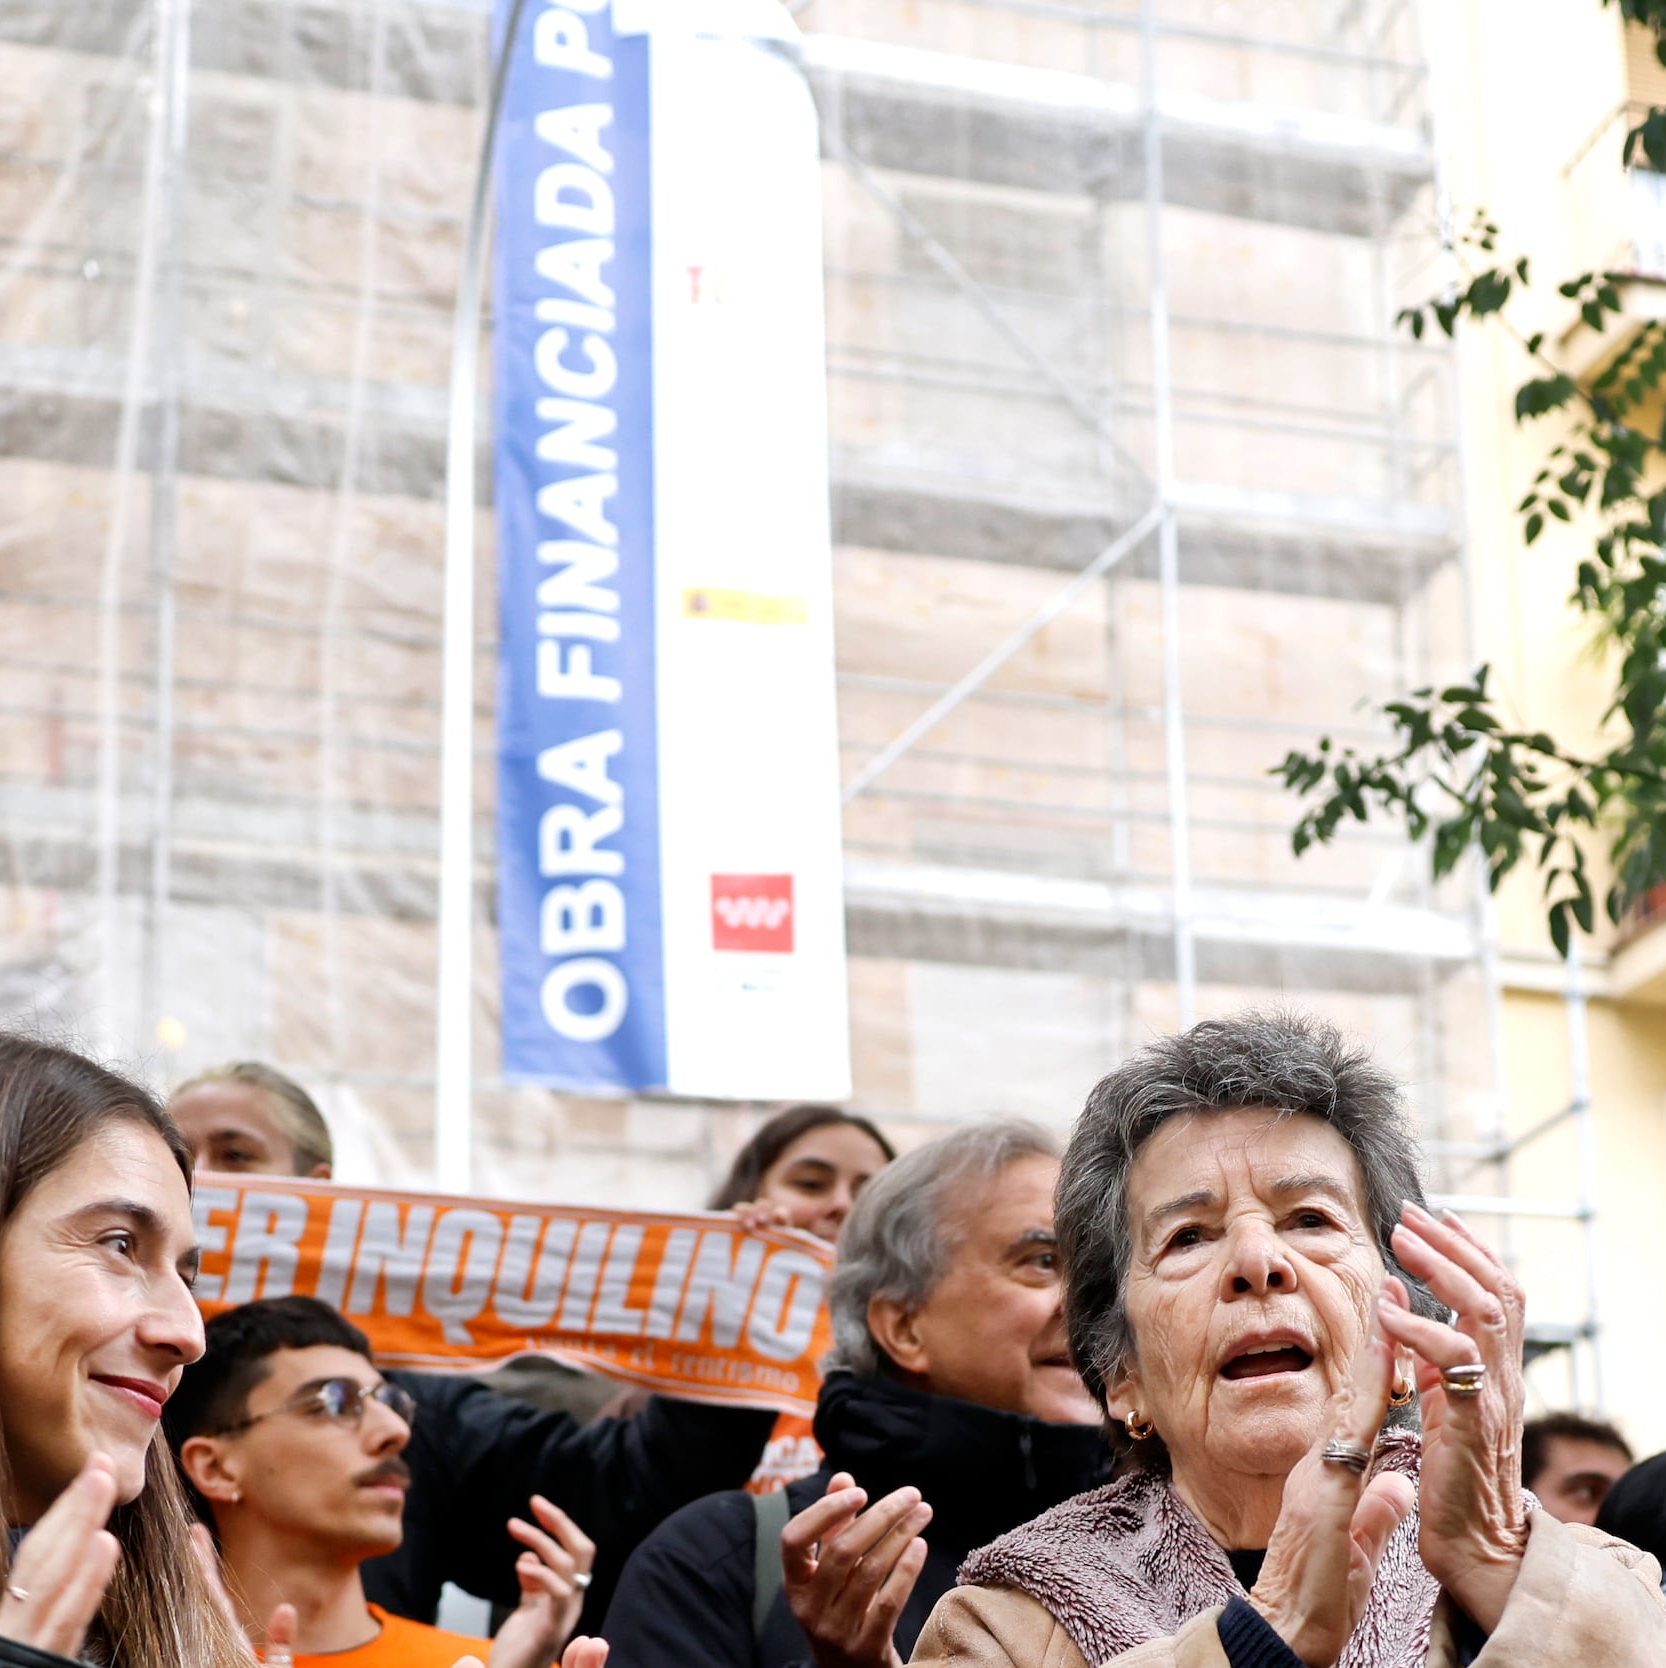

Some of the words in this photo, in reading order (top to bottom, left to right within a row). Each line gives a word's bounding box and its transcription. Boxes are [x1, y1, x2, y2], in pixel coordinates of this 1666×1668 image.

[534, 0, 614, 80] P
[534, 102, 622, 703] FINANCIADA
[537, 730, 629, 1042] OBRA
[315, 1197, 825, 1362] INQUILINO
